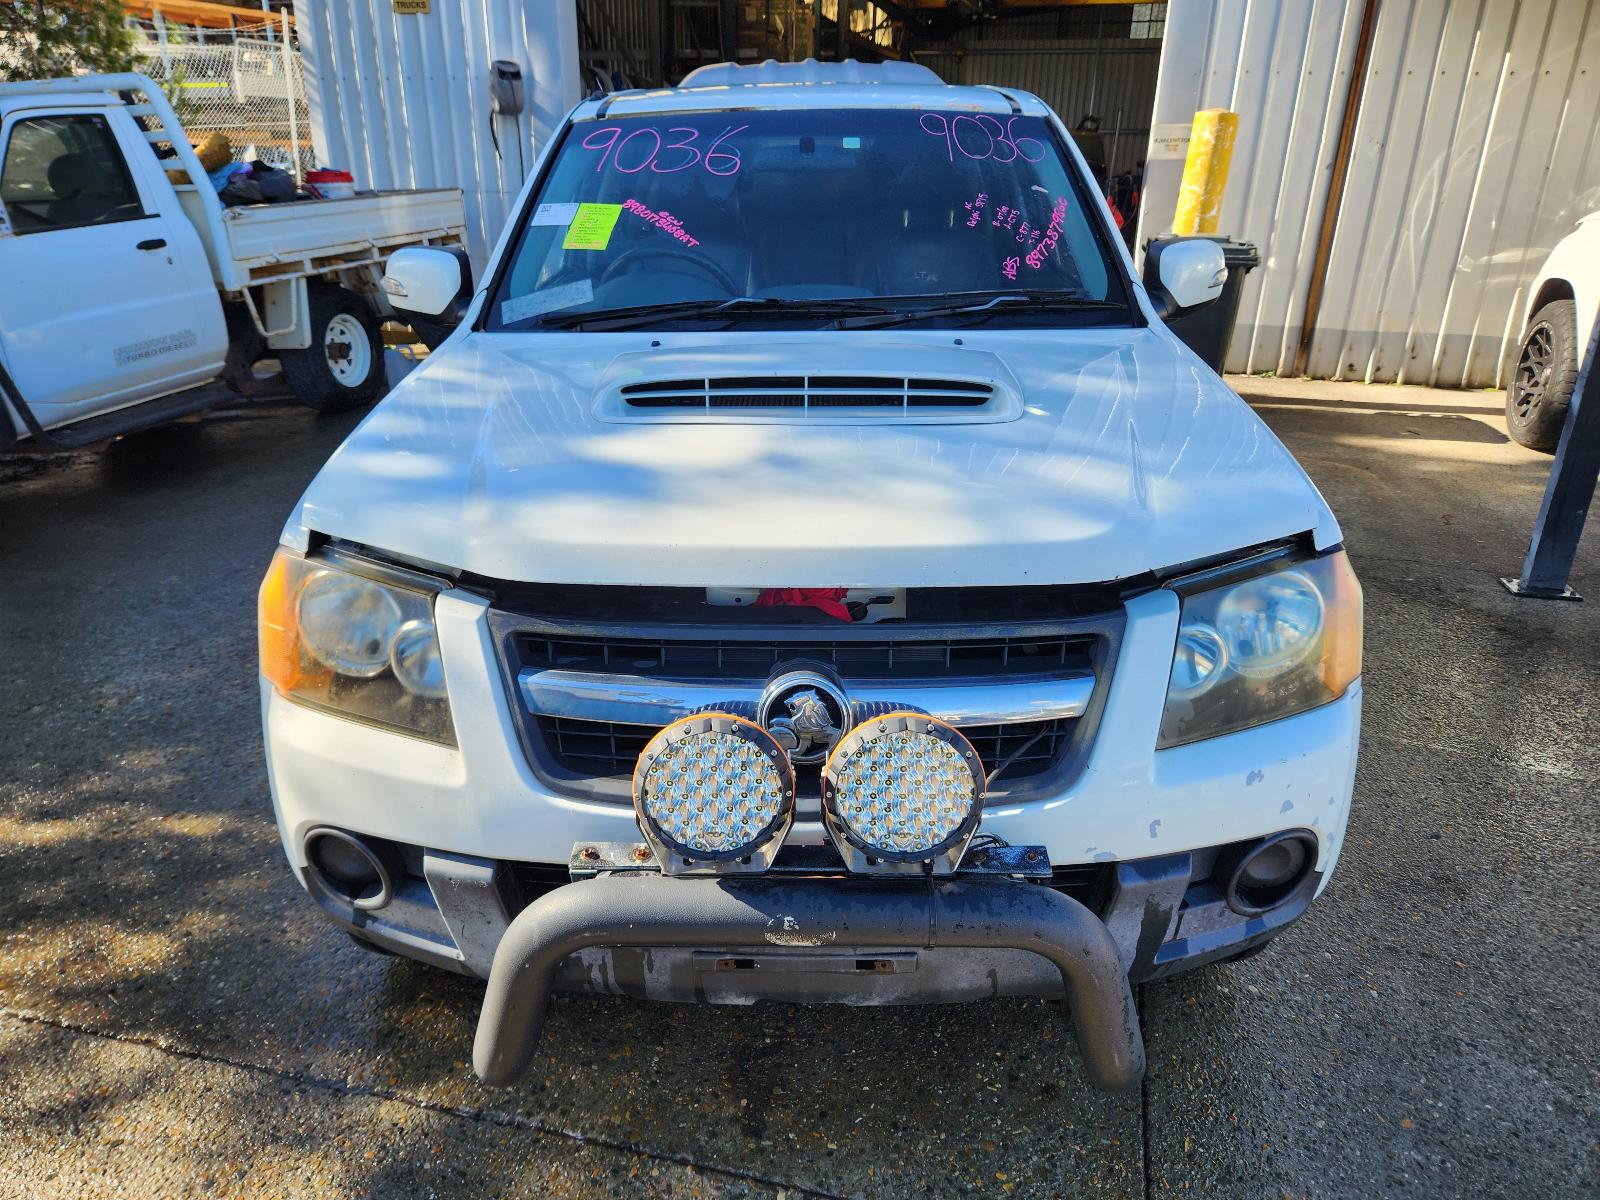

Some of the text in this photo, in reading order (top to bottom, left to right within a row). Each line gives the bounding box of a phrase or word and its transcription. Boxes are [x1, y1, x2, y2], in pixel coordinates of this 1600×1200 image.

[396, 1, 427, 9] TRUCKS
[582, 125, 749, 177] 9036
[919, 113, 1046, 163] 9036
[1002, 256, 1020, 280] ABS
